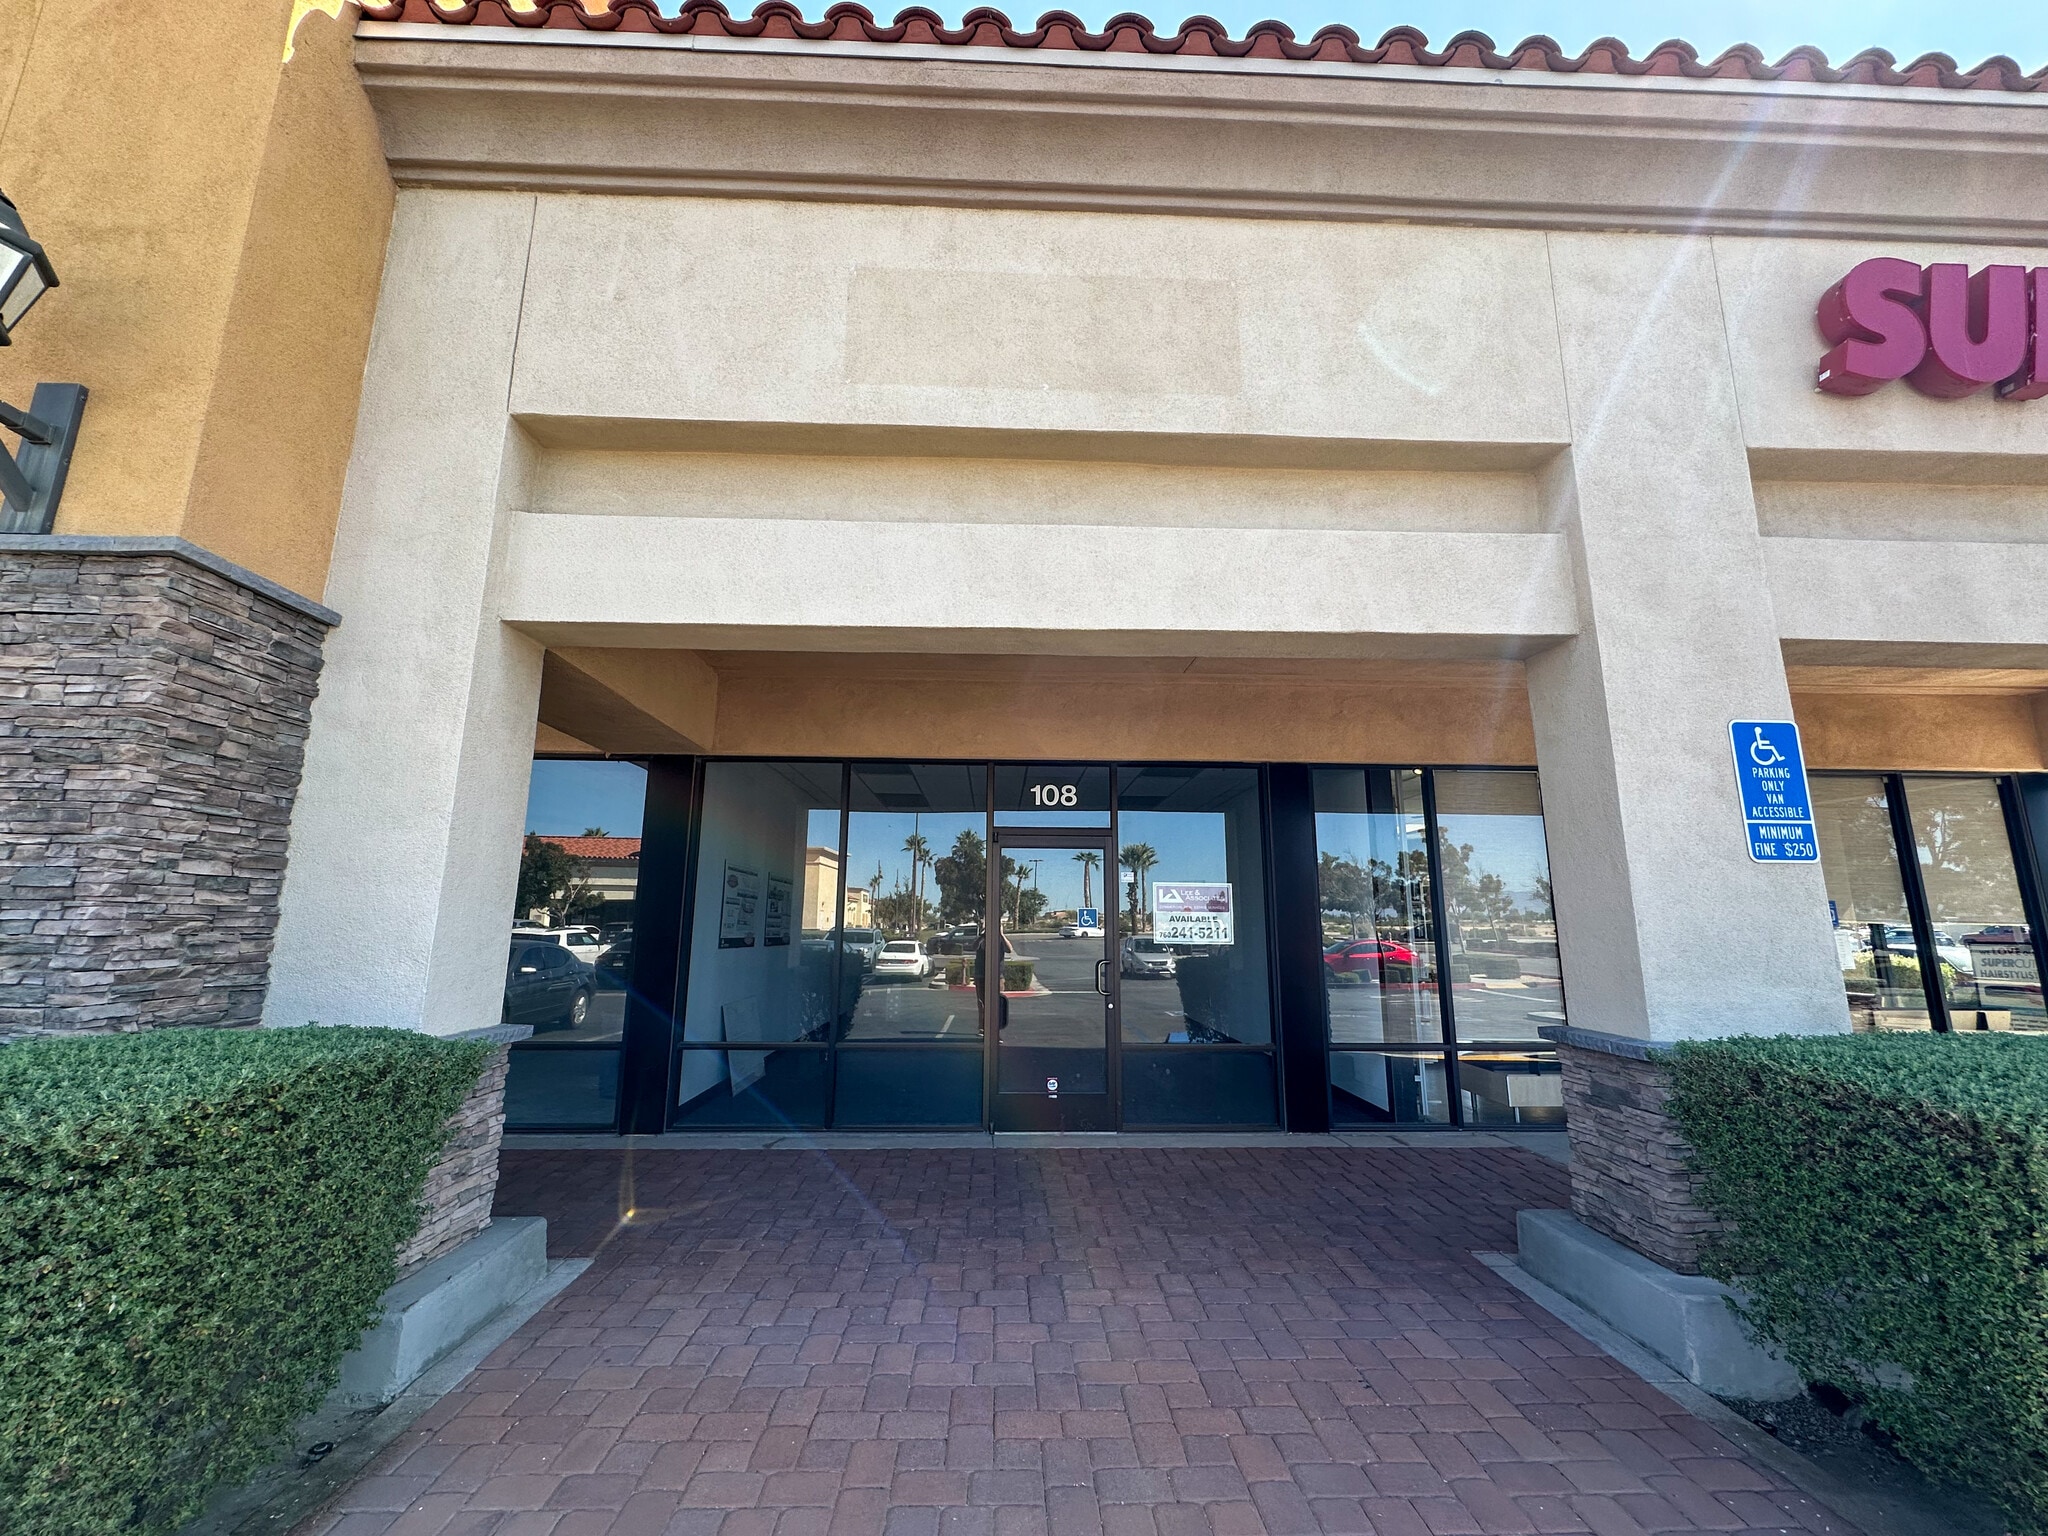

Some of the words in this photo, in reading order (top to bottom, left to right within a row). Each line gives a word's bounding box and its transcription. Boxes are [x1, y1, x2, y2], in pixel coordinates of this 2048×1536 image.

[1817, 256, 2048, 400] SU
[1752, 767, 1790, 779] PARKING
[1761, 780, 1785, 792] ONLY
[1030, 784, 1078, 807] 108
[1766, 793, 1784, 804] VAN
[1752, 806, 1804, 818] ACCESSIBLE
[1759, 826, 1803, 840] MINIMUM
[1754, 842, 1777, 856] FINE
[1784, 842, 1814, 858] $250
[1171, 927, 1227, 939] 241-5211
